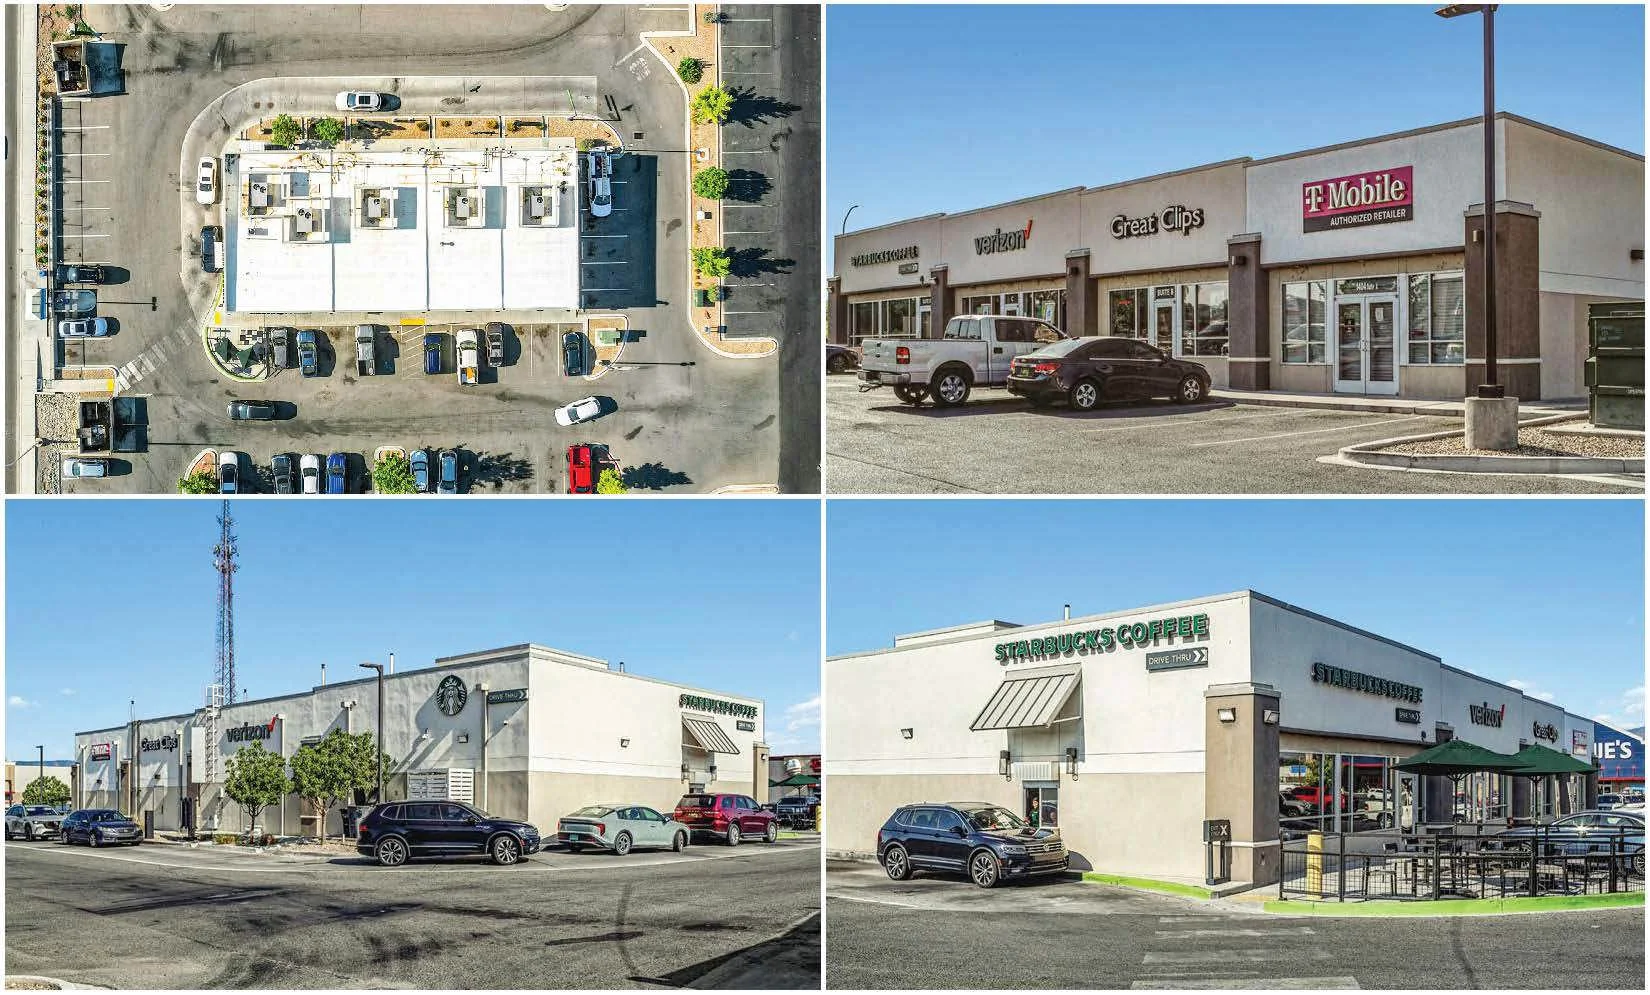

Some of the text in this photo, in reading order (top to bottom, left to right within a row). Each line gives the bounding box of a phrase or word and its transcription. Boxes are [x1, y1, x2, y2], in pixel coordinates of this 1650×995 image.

[1328, 174, 1406, 211] Mobile
[1110, 204, 1204, 239] Great Clips
[1331, 209, 1407, 227] AUTHORIZED RETAILER
[974, 226, 1028, 256] verizon
[995, 613, 1210, 662] STARBUCKS COFFEE
[1149, 651, 1192, 665] DRIVE THRU
[1312, 662, 1389, 697] STARBUCKS
[680, 694, 730, 716] STARBUCKS
[1469, 701, 1502, 728] verizon
[141, 735, 179, 752] Great Clips
[226, 721, 271, 743] verizon
